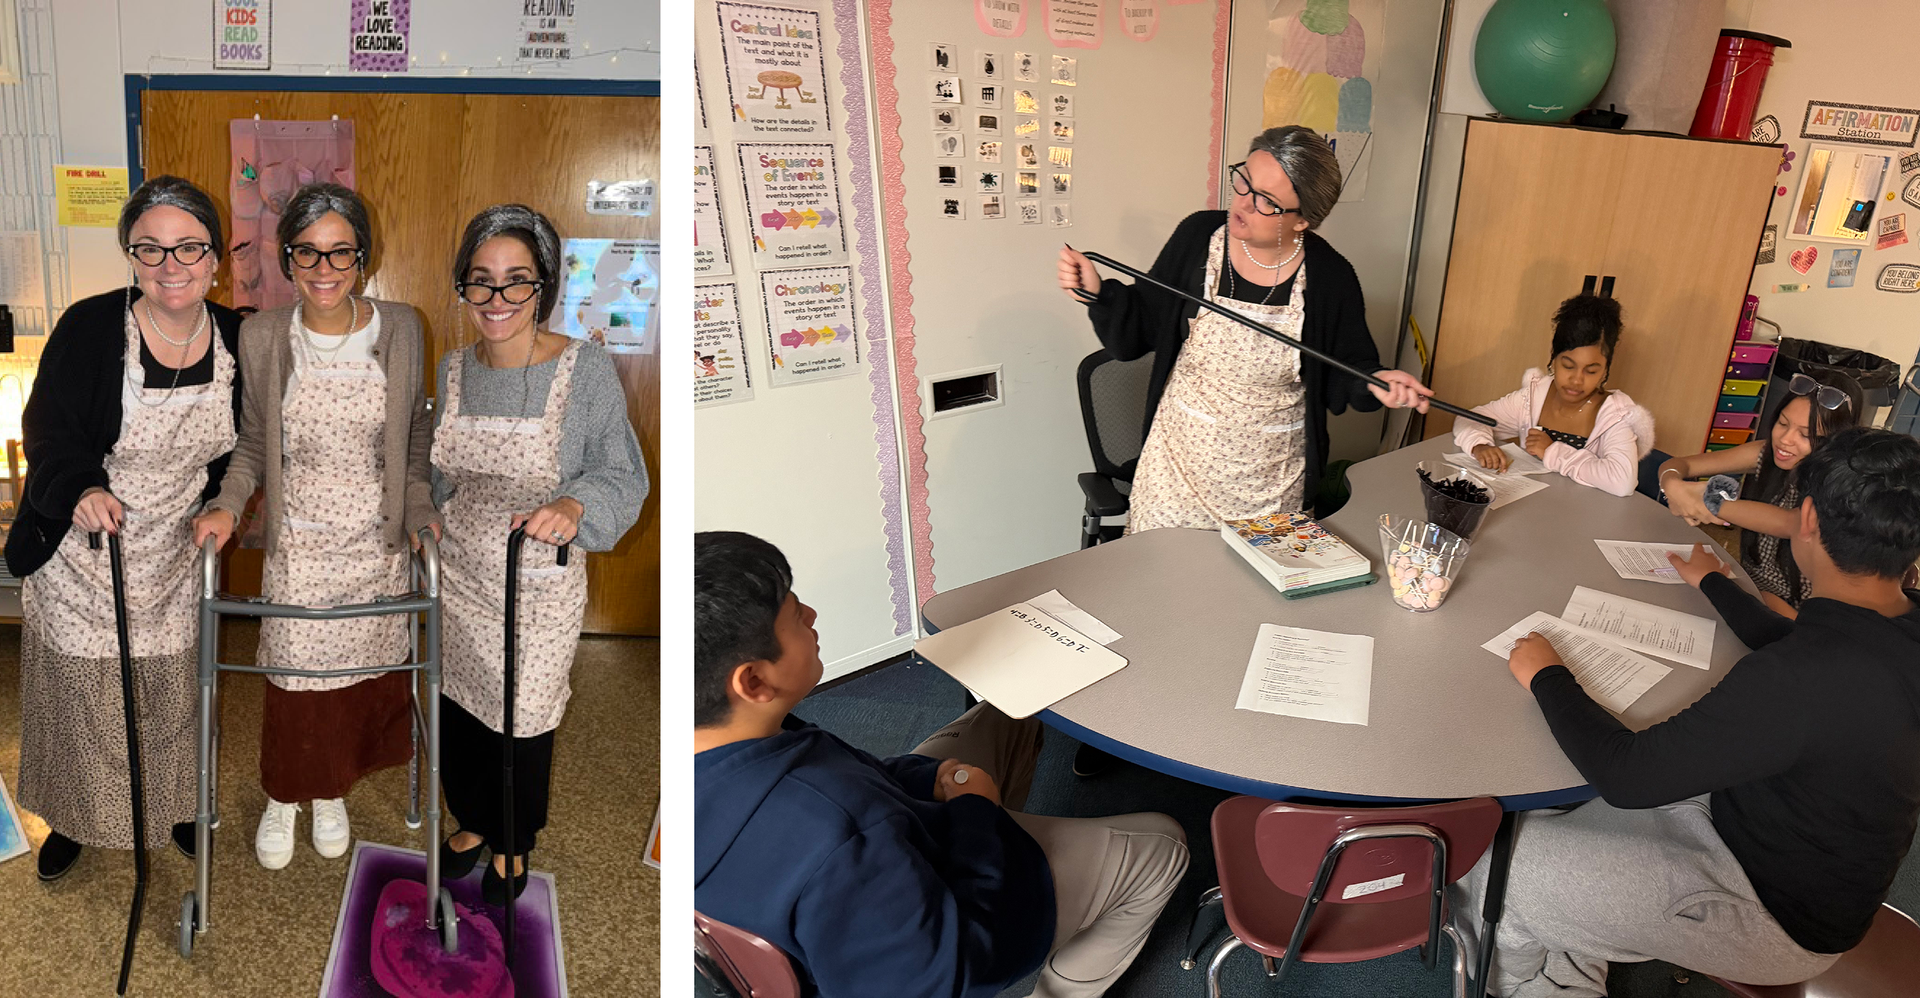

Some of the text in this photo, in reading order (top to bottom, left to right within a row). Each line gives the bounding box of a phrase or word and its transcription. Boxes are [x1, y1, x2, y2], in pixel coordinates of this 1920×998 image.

[374, 1, 388, 16] WE
[524, 0, 574, 17] READING
[227, 8, 256, 25] KIDS
[367, 18, 393, 33] LOVE
[730, 19, 813, 39] Central Idea
[225, 27, 258, 42] READ
[529, 33, 566, 43] ADVENTURE
[736, 36, 750, 44] The
[356, 36, 402, 50] READING
[221, 44, 262, 59] BOOKS
[519, 48, 533, 58] THAT
[755, 58, 778, 66] mostly
[1812, 108, 1914, 133] AFFIRMATION
[1752, 125, 1765, 139] ARE
[1837, 127, 1881, 139] Station
[759, 155, 824, 168] Sequence
[86, 170, 107, 178] DRILL
[764, 169, 824, 182] of Events
[1831, 268, 1853, 277] CONFIDENT
[1897, 270, 1920, 279] BELONG
[775, 282, 846, 296] Chronology
